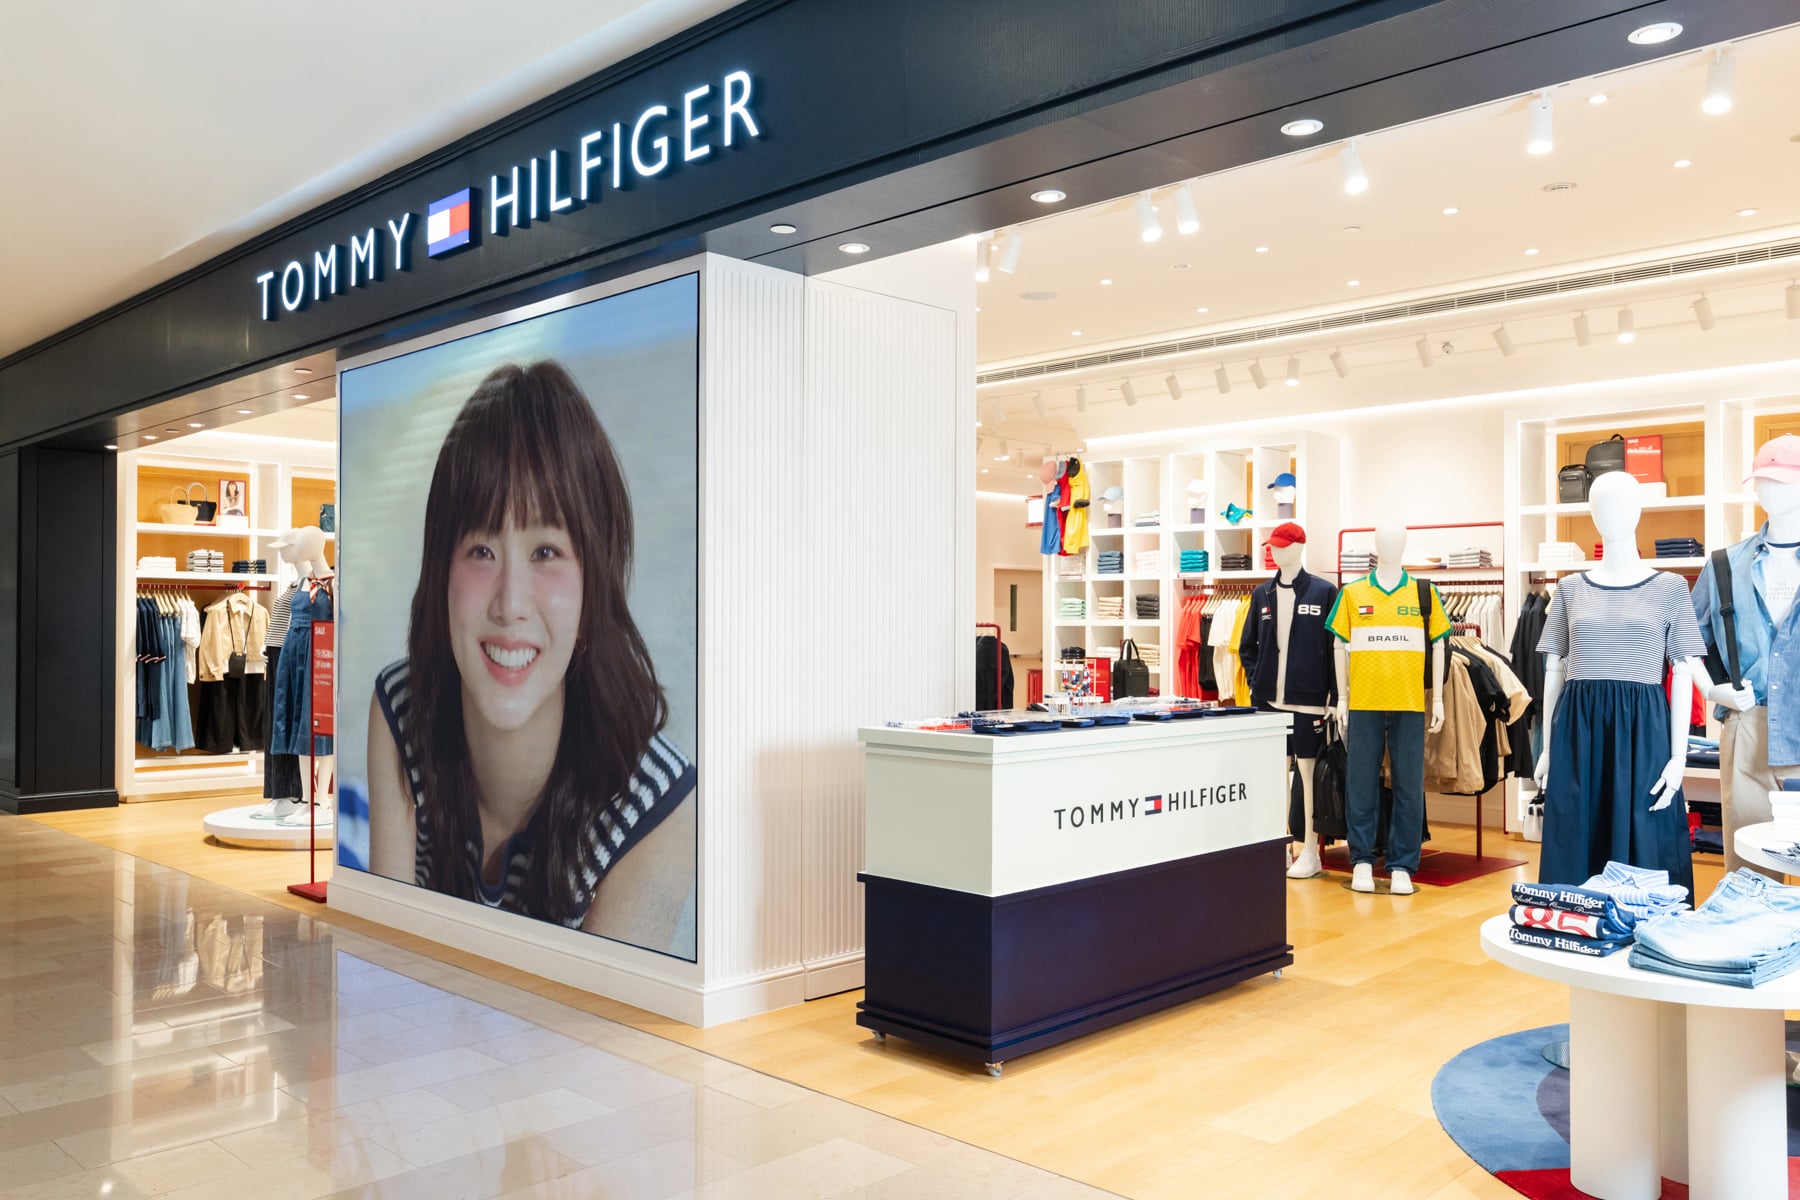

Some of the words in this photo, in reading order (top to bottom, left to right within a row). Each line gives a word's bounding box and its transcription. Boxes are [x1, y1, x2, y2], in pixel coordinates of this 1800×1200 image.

[256, 212, 411, 321] TOMMY
[491, 70, 760, 235] HILFIGER
[1297, 604, 1322, 616] 85
[1397, 605, 1421, 617] 85
[1053, 797, 1140, 830] TOMMY
[1168, 782, 1248, 812] HILFIGER
[1514, 882, 1558, 901] Tommy
[1559, 890, 1606, 909] Hilfiger
[1523, 905, 1592, 938] 85
[1508, 927, 1552, 947] Tommy
